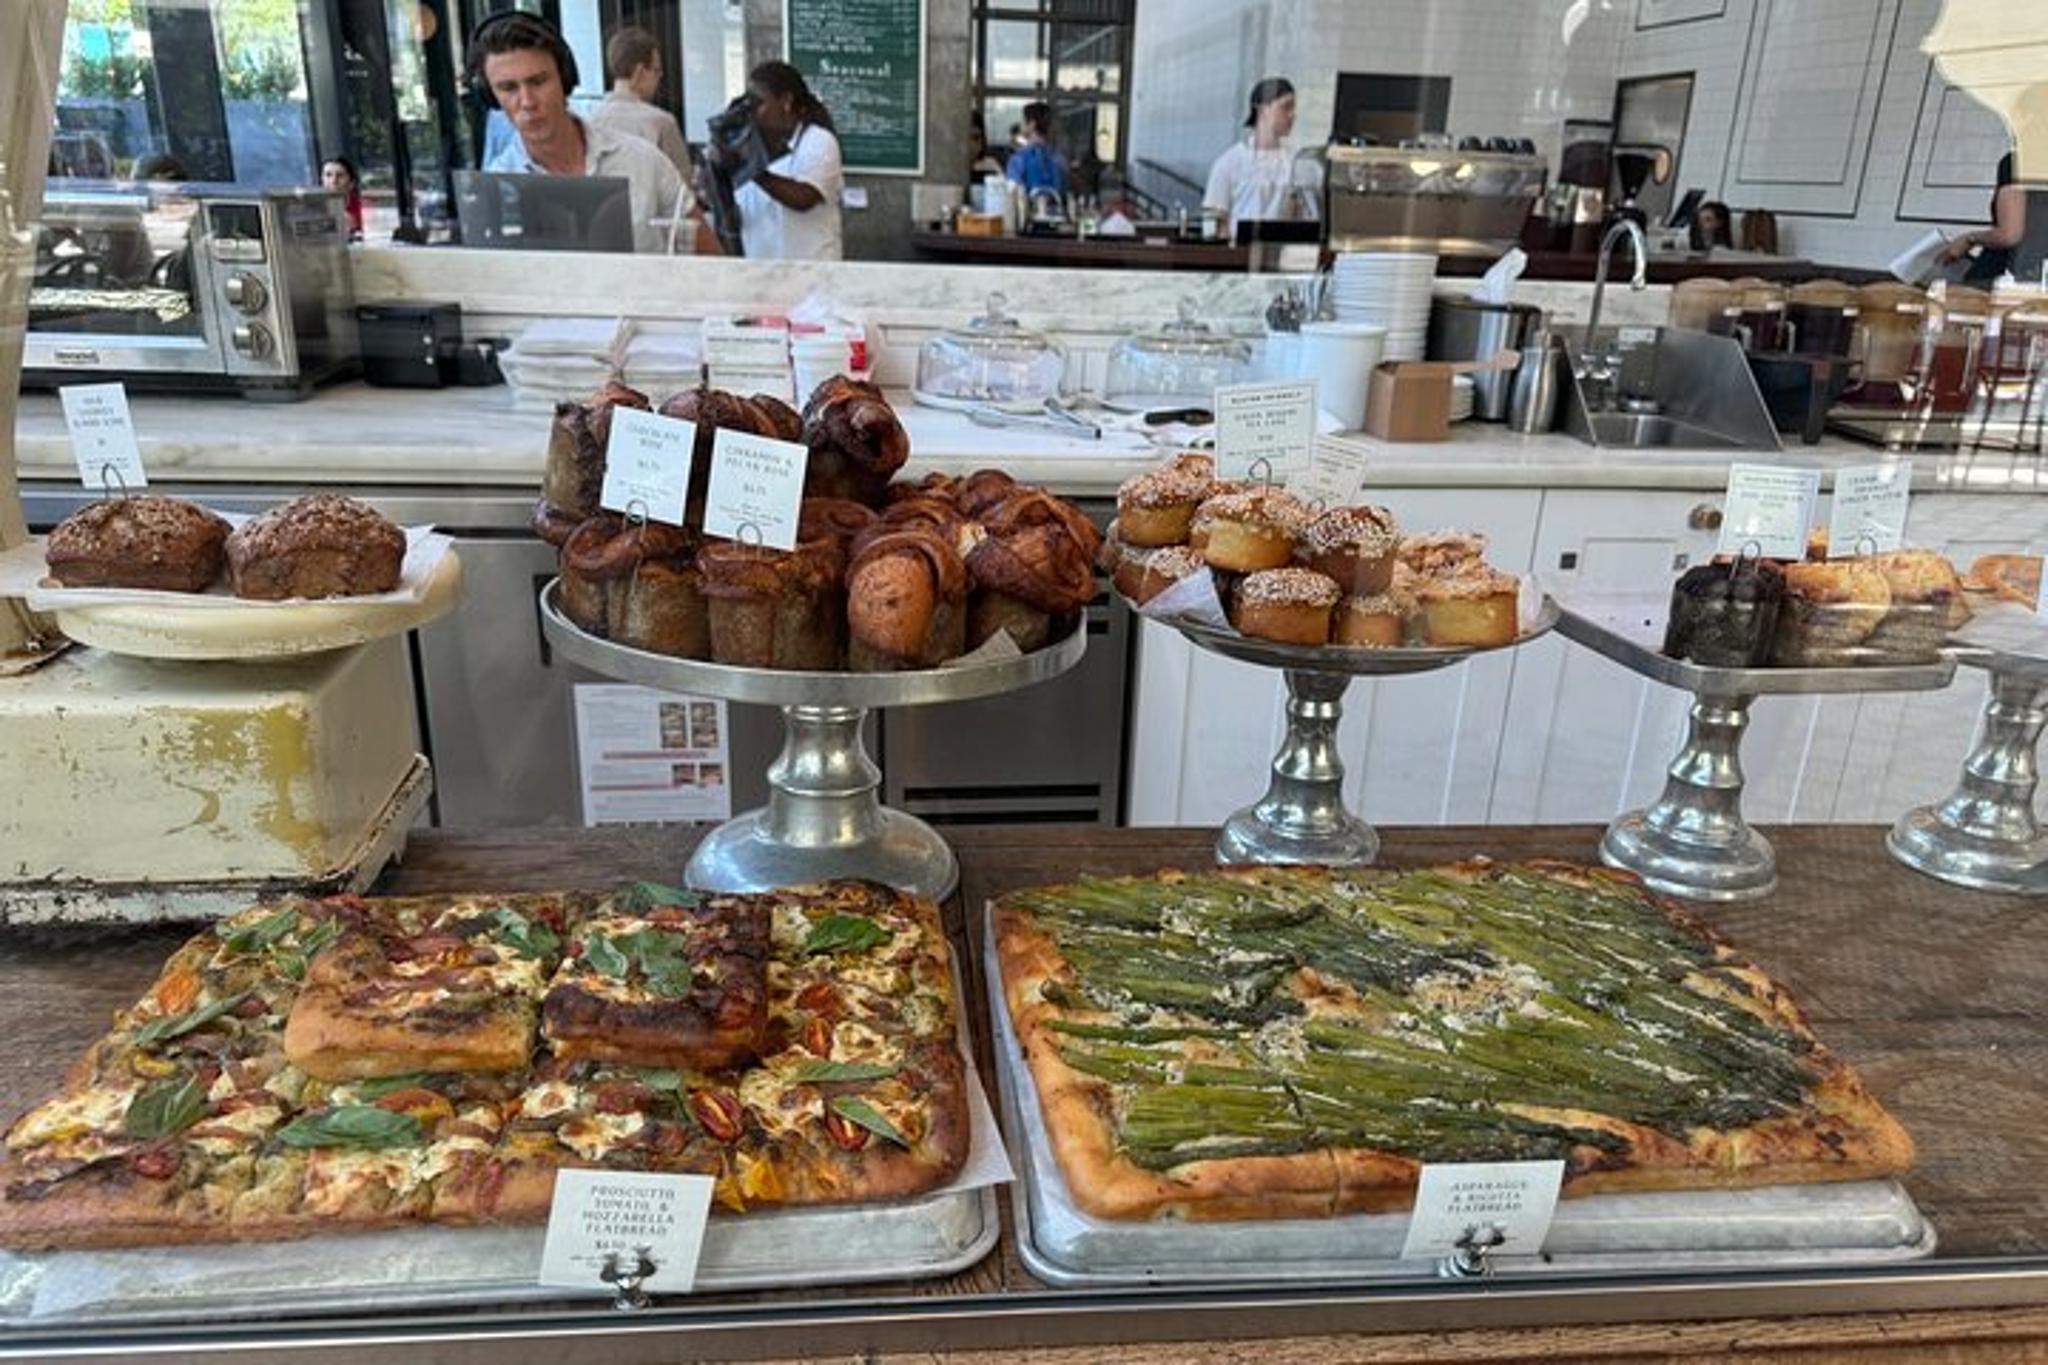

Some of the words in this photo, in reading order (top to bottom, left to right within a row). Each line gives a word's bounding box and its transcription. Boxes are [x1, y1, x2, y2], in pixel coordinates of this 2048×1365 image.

[819, 58, 891, 78] Seasonal
[724, 445, 781, 464] CINNAMON
[725, 457, 760, 472] PECAN
[590, 1184, 675, 1200] PROSCIUTTO
[1450, 1181, 1527, 1192] ASPARAGUS
[1468, 1191, 1521, 1202] RICOTTA
[594, 1197, 650, 1210] TOMATO
[659, 1201, 669, 1212] &
[1447, 1202, 1523, 1213] FLATBREAD
[582, 1210, 675, 1224] MOZZARELLA
[585, 1222, 668, 1236] FLATBREAD
